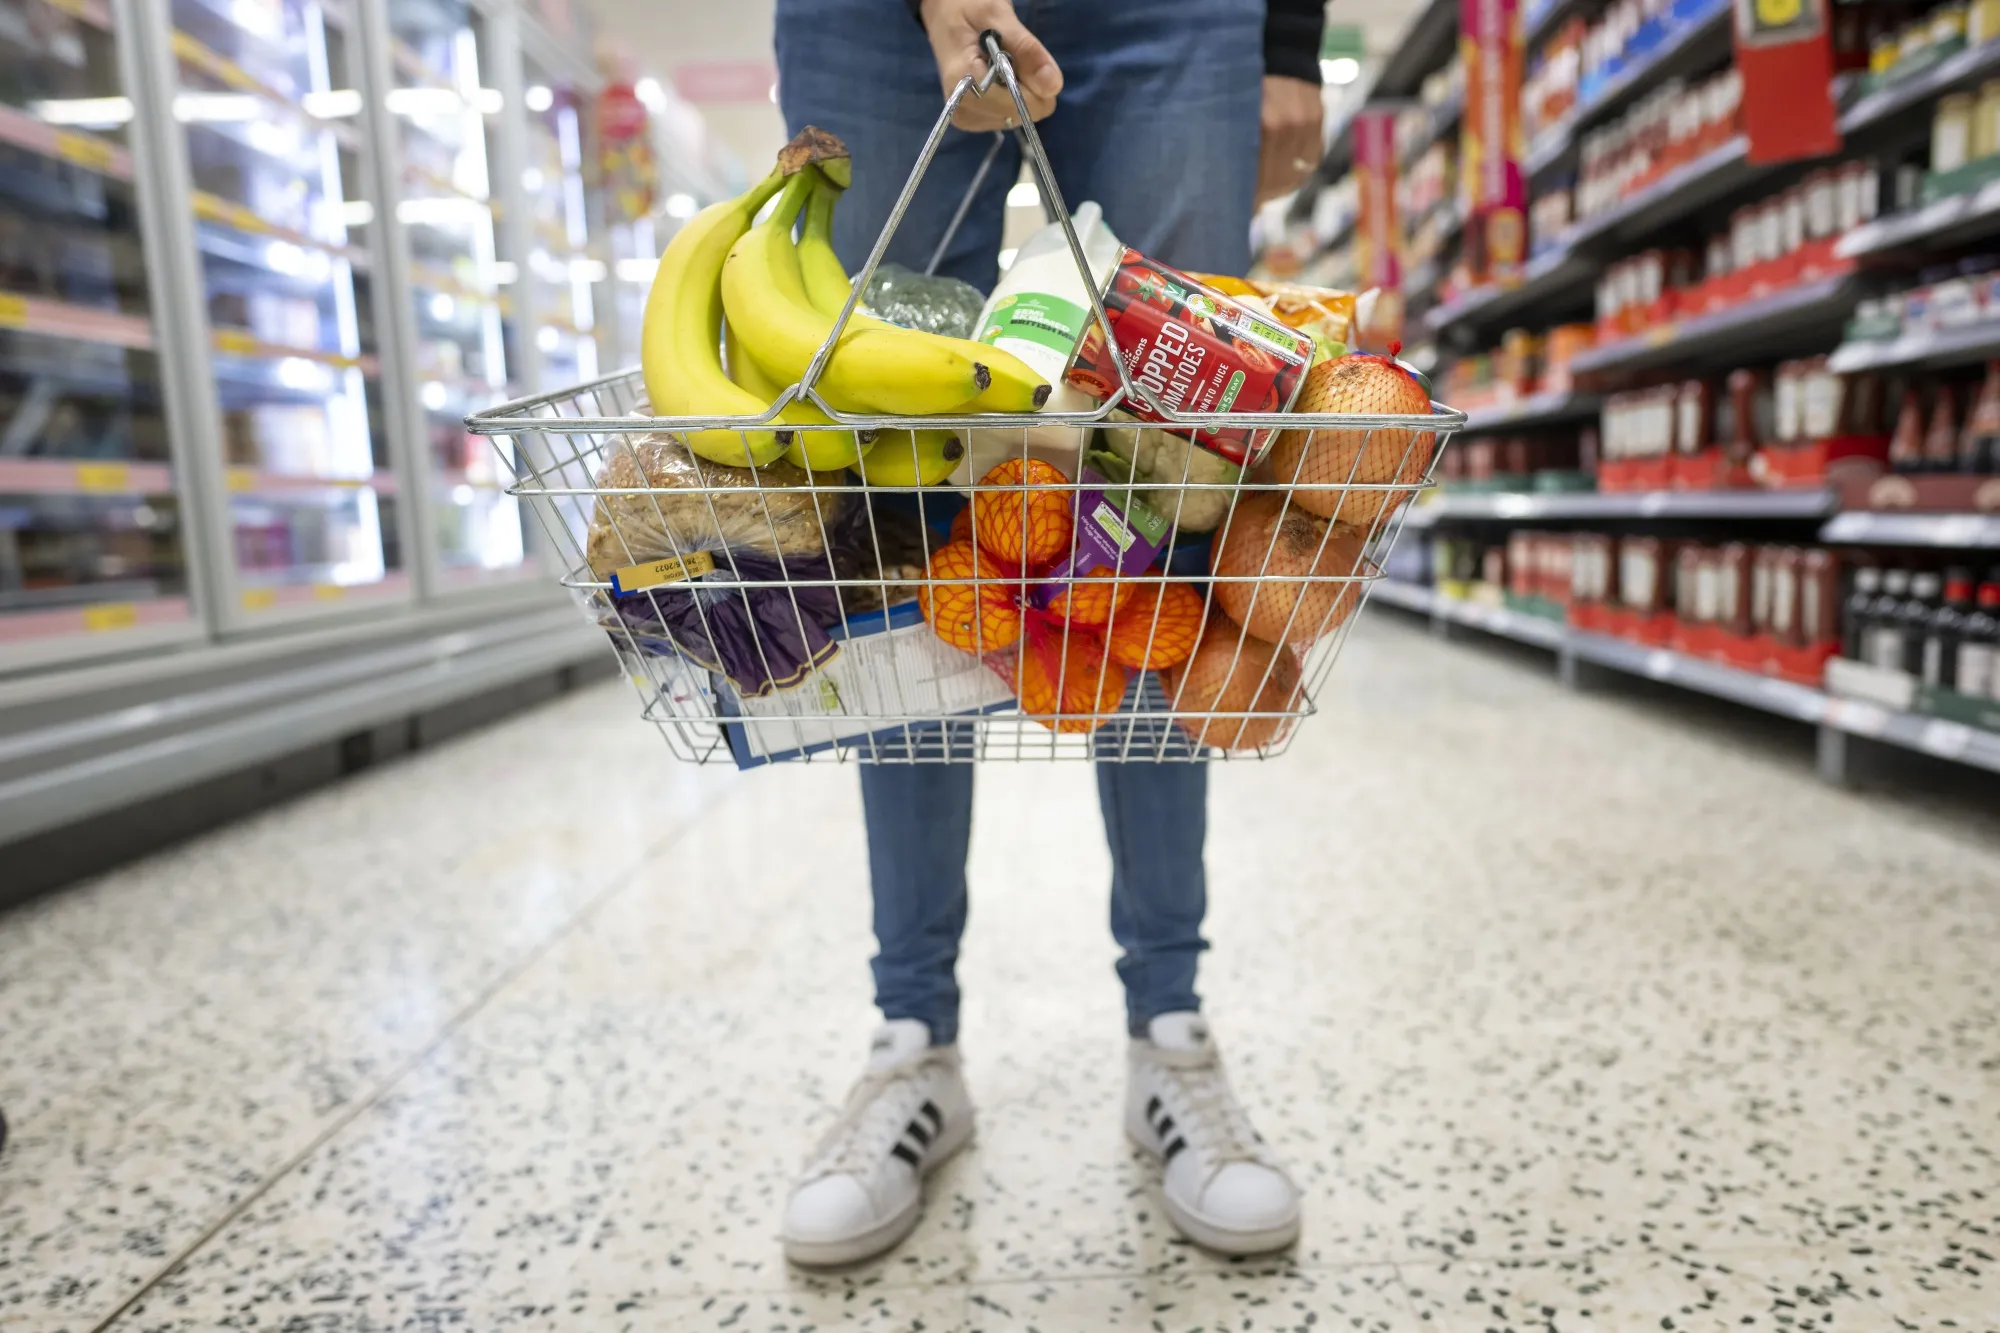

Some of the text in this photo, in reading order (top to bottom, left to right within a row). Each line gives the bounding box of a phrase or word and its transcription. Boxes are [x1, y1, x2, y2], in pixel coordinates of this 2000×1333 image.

[1010, 319, 1057, 333] BRITISH
[1128, 337, 1148, 376] orrisons
[1128, 321, 1189, 413] COPPED
[1161, 342, 1206, 413] OMATOES
[1198, 362, 1229, 413] OMATO JUICE
[1223, 395, 1233, 404] 5
[1231, 378, 1240, 391] DAY
